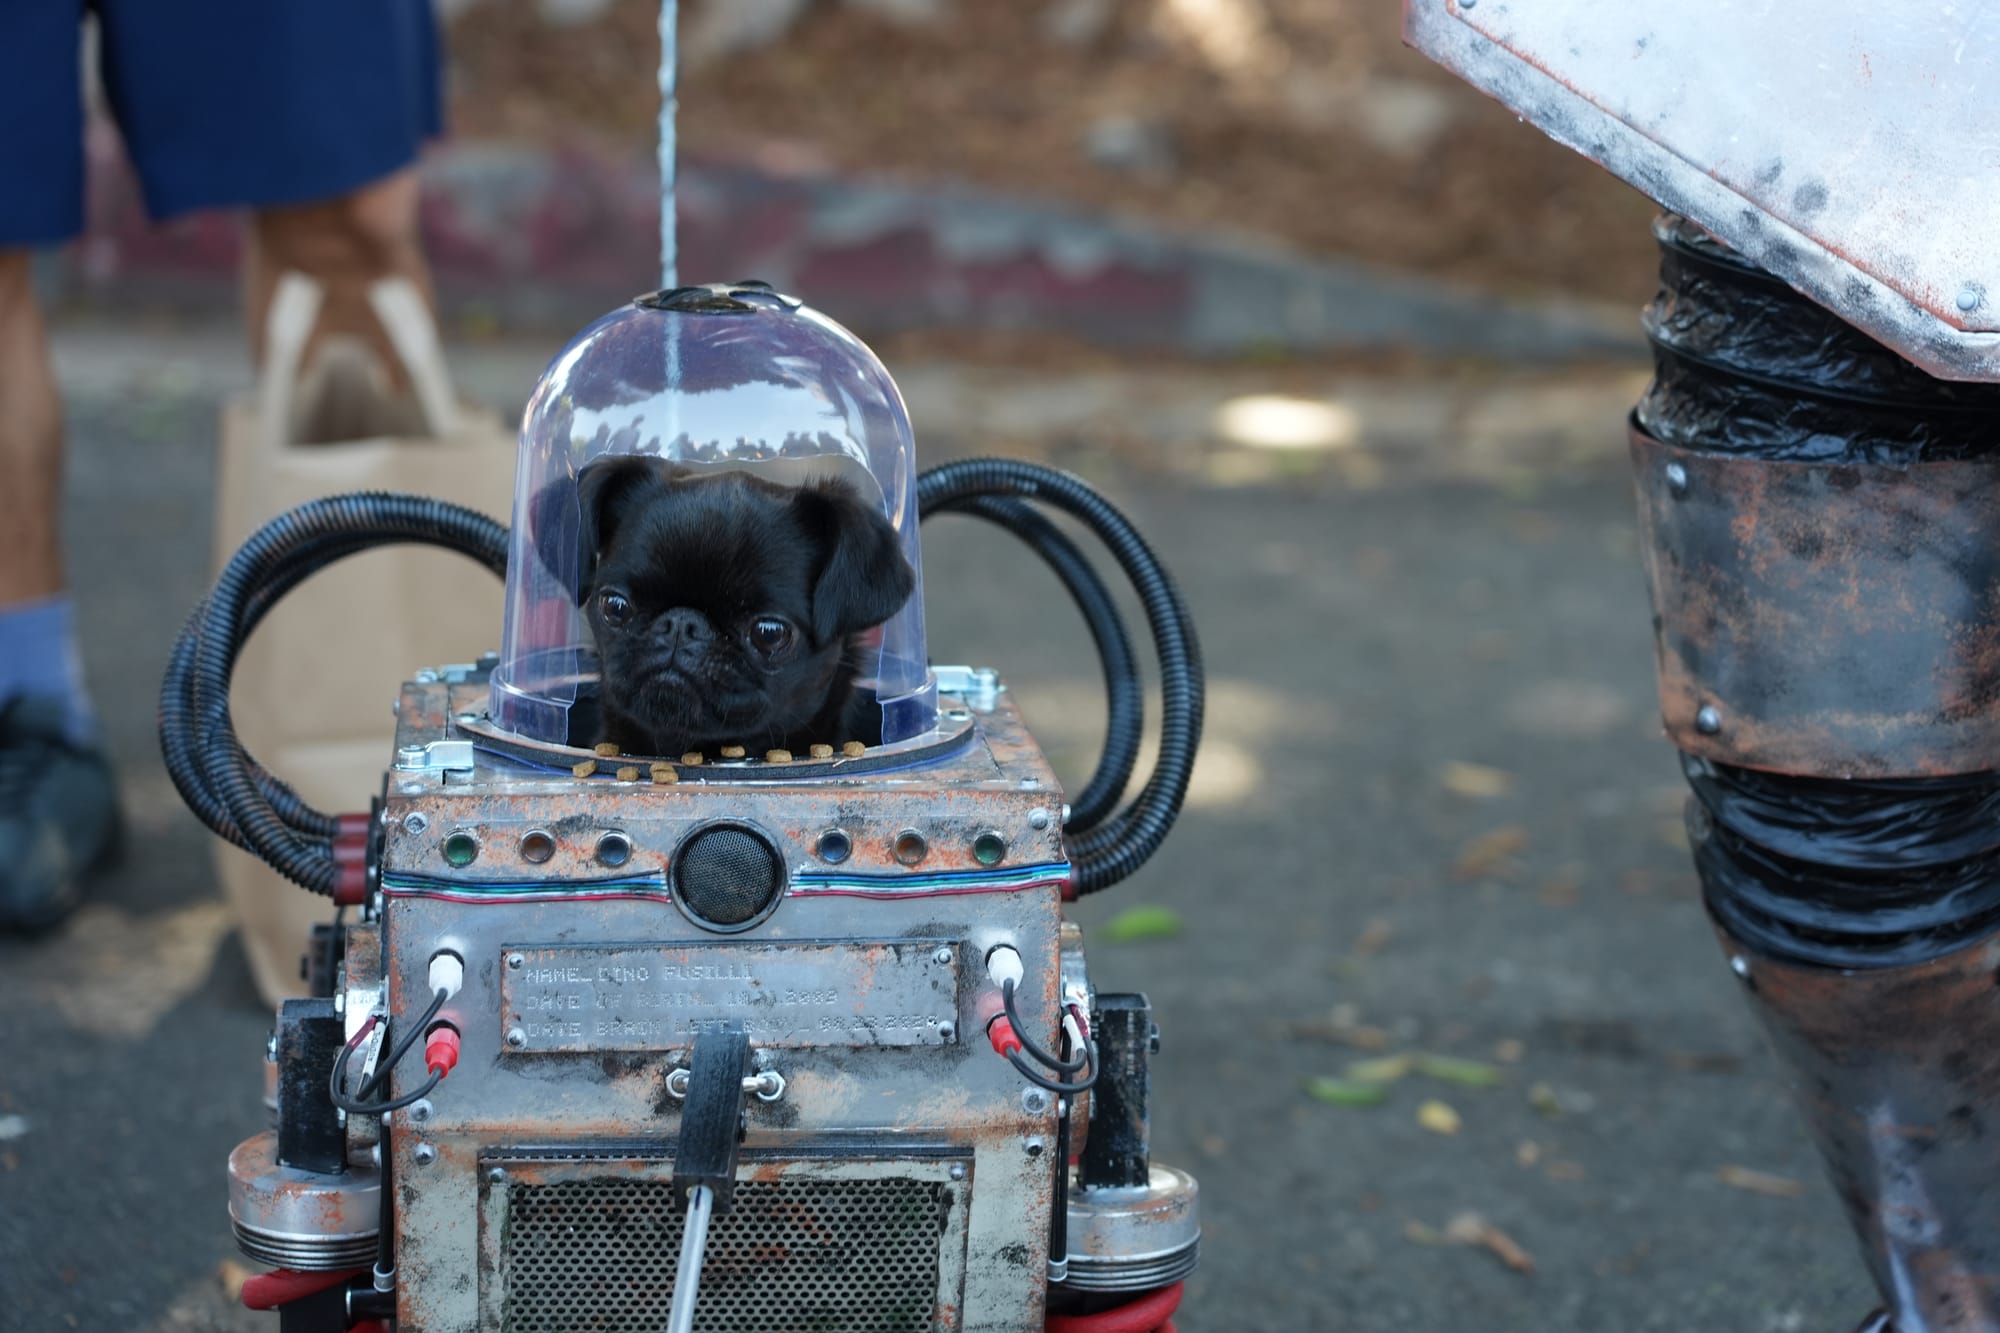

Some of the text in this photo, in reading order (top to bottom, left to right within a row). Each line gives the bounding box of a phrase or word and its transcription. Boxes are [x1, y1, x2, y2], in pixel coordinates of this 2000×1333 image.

[598, 966, 649, 982] DINO
[663, 964, 752, 981] FUSILLI
[527, 1022, 581, 1037] DATE
[596, 1020, 660, 1036] BRAIN
